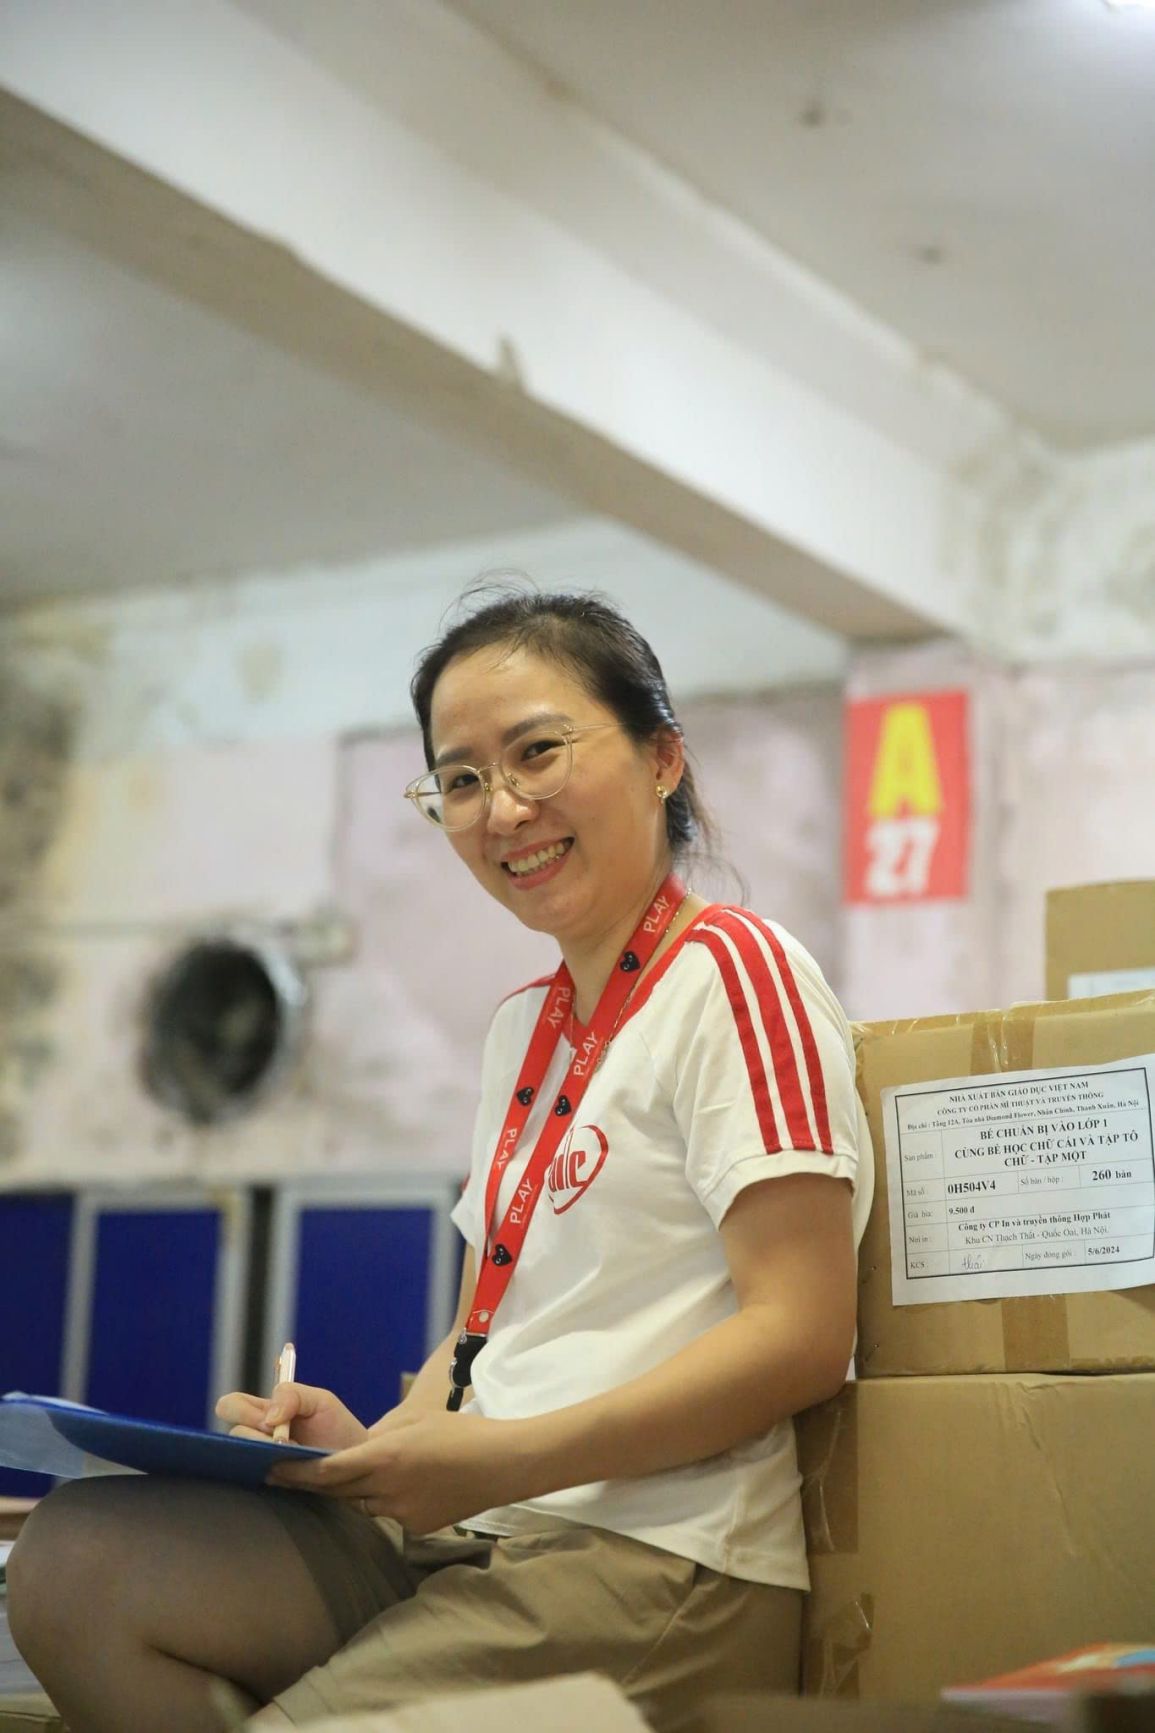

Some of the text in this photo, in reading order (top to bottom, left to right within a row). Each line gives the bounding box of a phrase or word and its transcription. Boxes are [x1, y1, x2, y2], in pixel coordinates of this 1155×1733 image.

[868, 703, 943, 817] A
[643, 896, 669, 933] PLAY
[547, 986, 571, 1029] PLAY
[573, 1031, 599, 1077] PLAY
[1008, 1086, 1029, 1096] GIÁO
[1030, 1085, 1047, 1095] DỤC
[1049, 1082, 1067, 1092] VIỆT
[1070, 1081, 1089, 1089] NAM
[937, 1106, 957, 1115] CÔNG
[1078, 1091, 1104, 1101] THÔNG
[980, 1117, 1108, 1140] BÉ CHUẨN BỊ VÀO LỚP 1
[497, 1127, 518, 1170] PLAY
[954, 1146, 985, 1159] CÙNG
[1004, 1143, 1028, 1156] HỌC
[1030, 1138, 1053, 1151] CHỮ
[1057, 1136, 1076, 1148] CÁI
[1079, 1133, 1095, 1145] VÀ
[1098, 1133, 1119, 1146] TẬP
[1004, 1154, 1029, 1167] CHỮ
[1037, 1153, 1058, 1165] TẬP
[1061, 1150, 1087, 1163] MỘT
[947, 1179, 996, 1194] 0H504V4
[1092, 1169, 1132, 1181] 260 bản
[509, 1178, 534, 1225] PLAY
[949, 1206, 975, 1215] 9.500 đ
[958, 1212, 1111, 1232] Công ty CP In và truyền thông Hợp Phát
[965, 1236, 980, 1245] Khu
[982, 1235, 993, 1243] CN
[996, 1233, 1018, 1243] Thạch
[1041, 1229, 1061, 1240] Quốc
[1080, 1226, 1092, 1235] Hà
[1087, 1246, 1120, 1256] 5/6/2024
